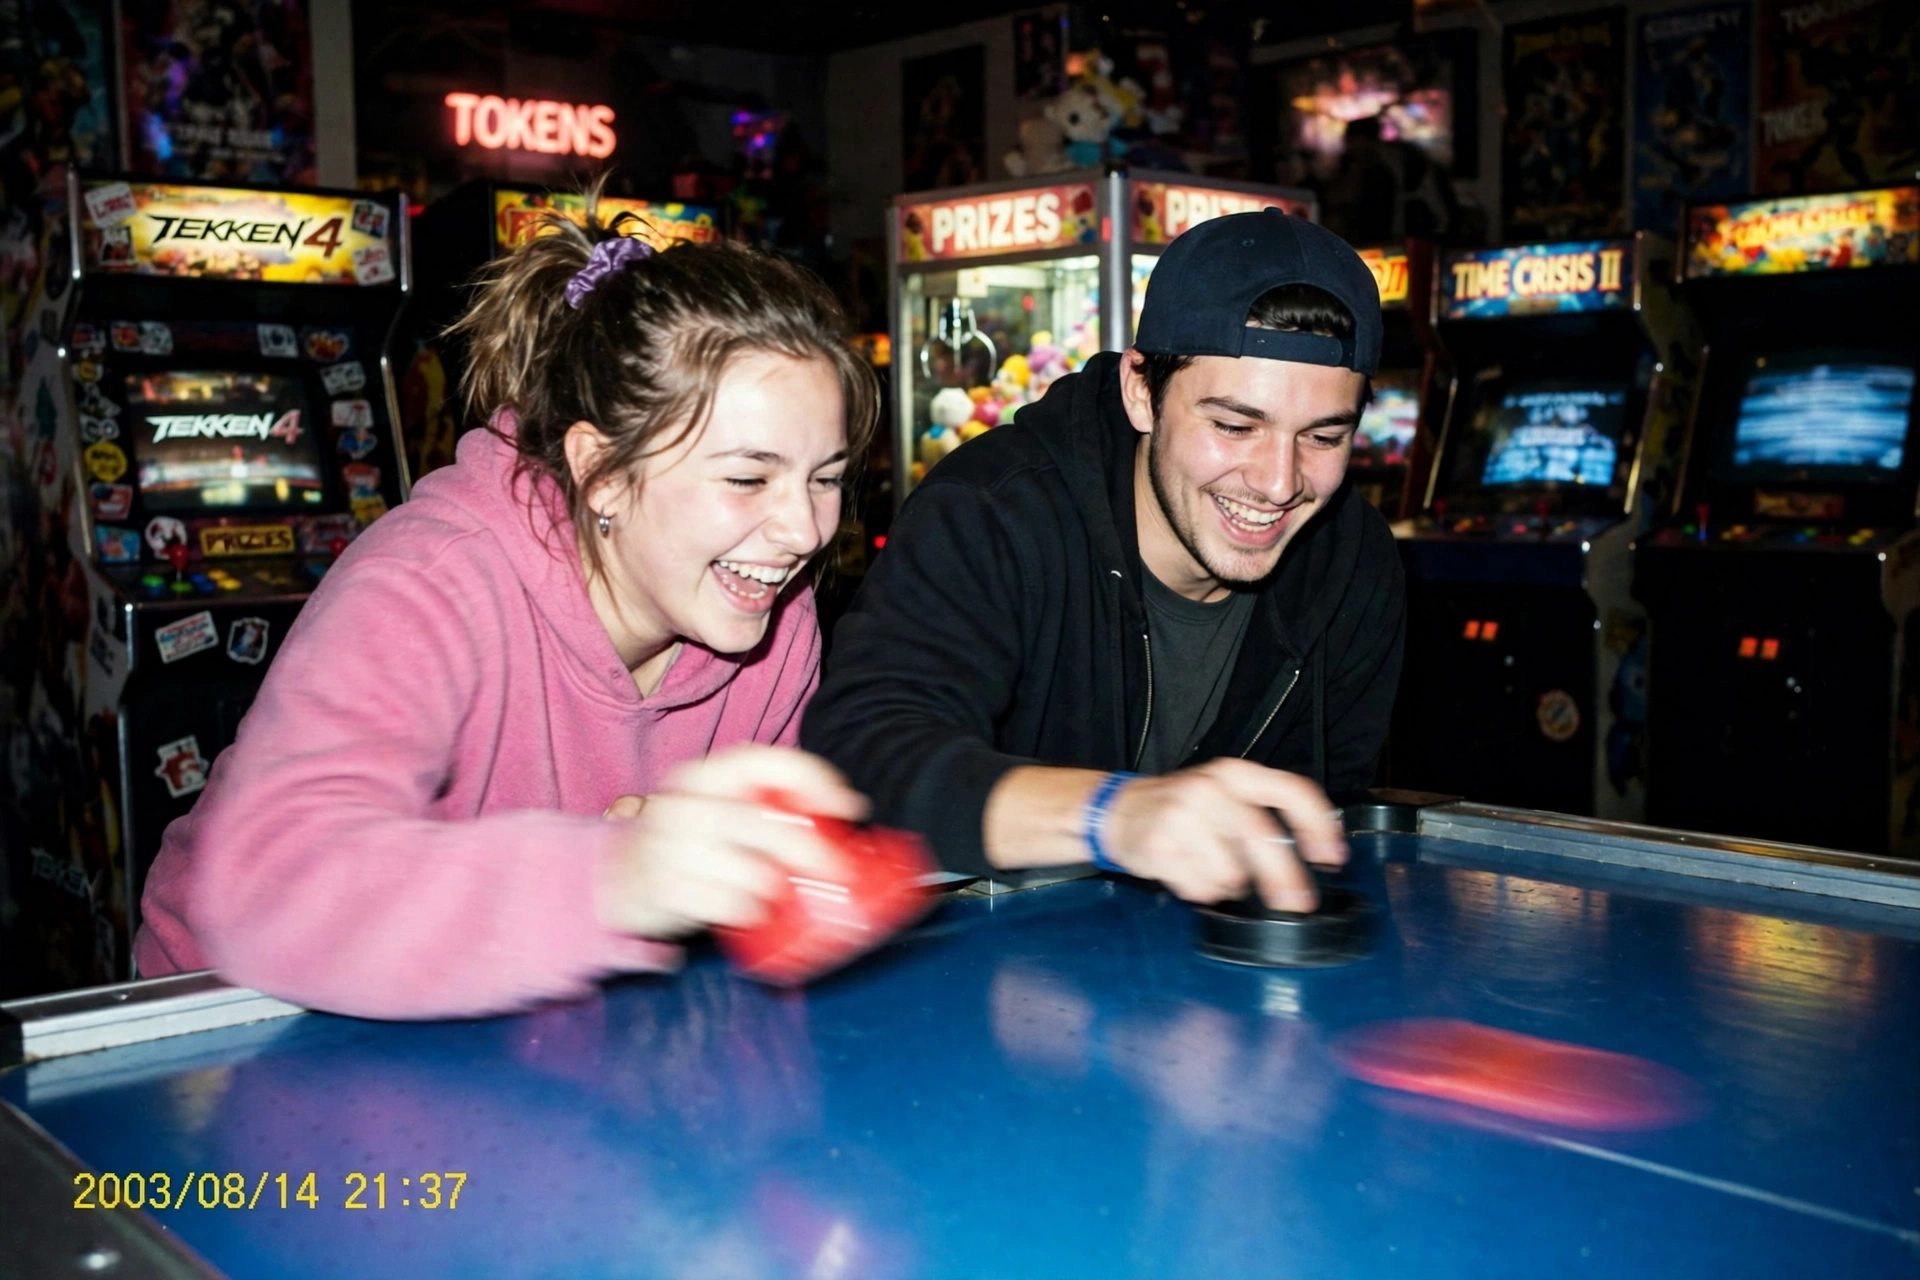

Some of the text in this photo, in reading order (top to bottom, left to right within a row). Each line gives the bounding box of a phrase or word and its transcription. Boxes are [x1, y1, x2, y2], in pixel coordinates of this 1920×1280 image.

[445, 92, 617, 158] TOKENS
[146, 213, 311, 249] TEKKEN
[304, 217, 343, 259] 4
[932, 193, 1061, 252] PRIZES
[1452, 260, 1510, 300] TIME
[1512, 252, 1596, 296] CRISIS
[1598, 250, 1623, 292] II
[146, 409, 304, 444] TEKKEN 4
